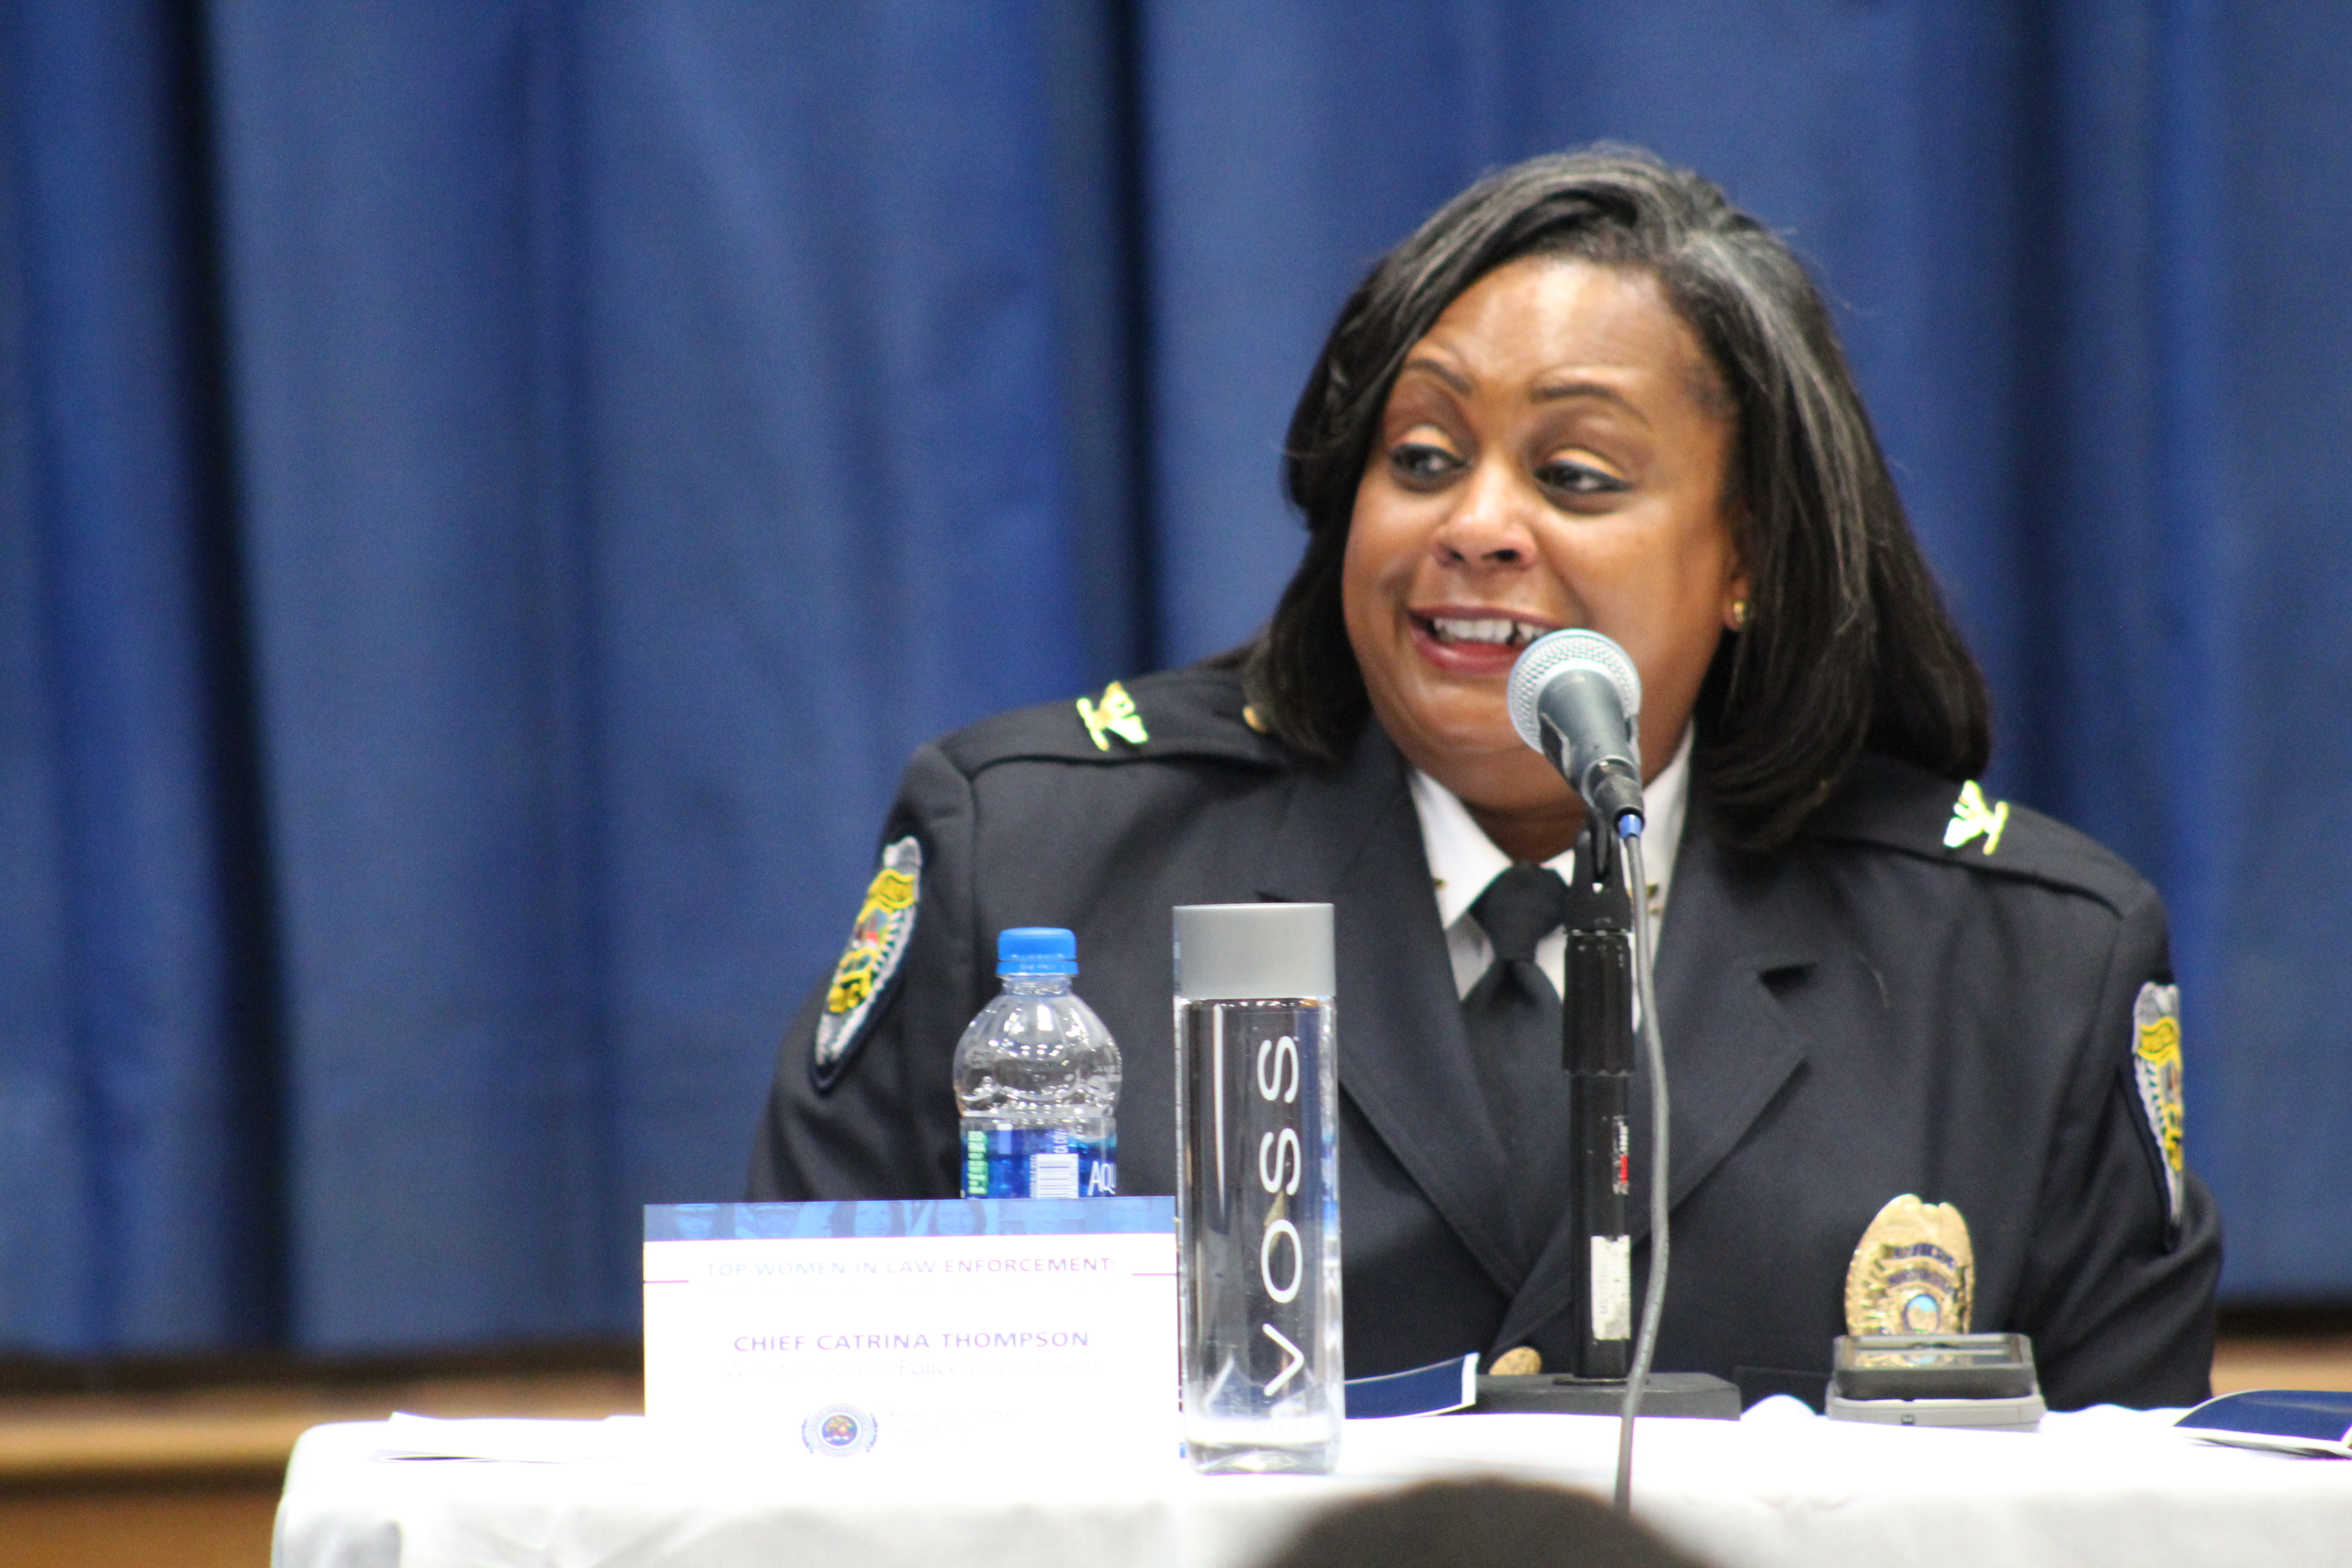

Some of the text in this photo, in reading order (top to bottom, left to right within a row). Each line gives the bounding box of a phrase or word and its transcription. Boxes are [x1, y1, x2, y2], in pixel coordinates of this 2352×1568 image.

[1257, 1035, 1305, 1396] VOSS
[706, 1257, 1115, 1277] TOP WOMEN IN LAW ENFORCEMENT:
[734, 1332, 1089, 1352] CHIEF CATRINA THOMPSON
